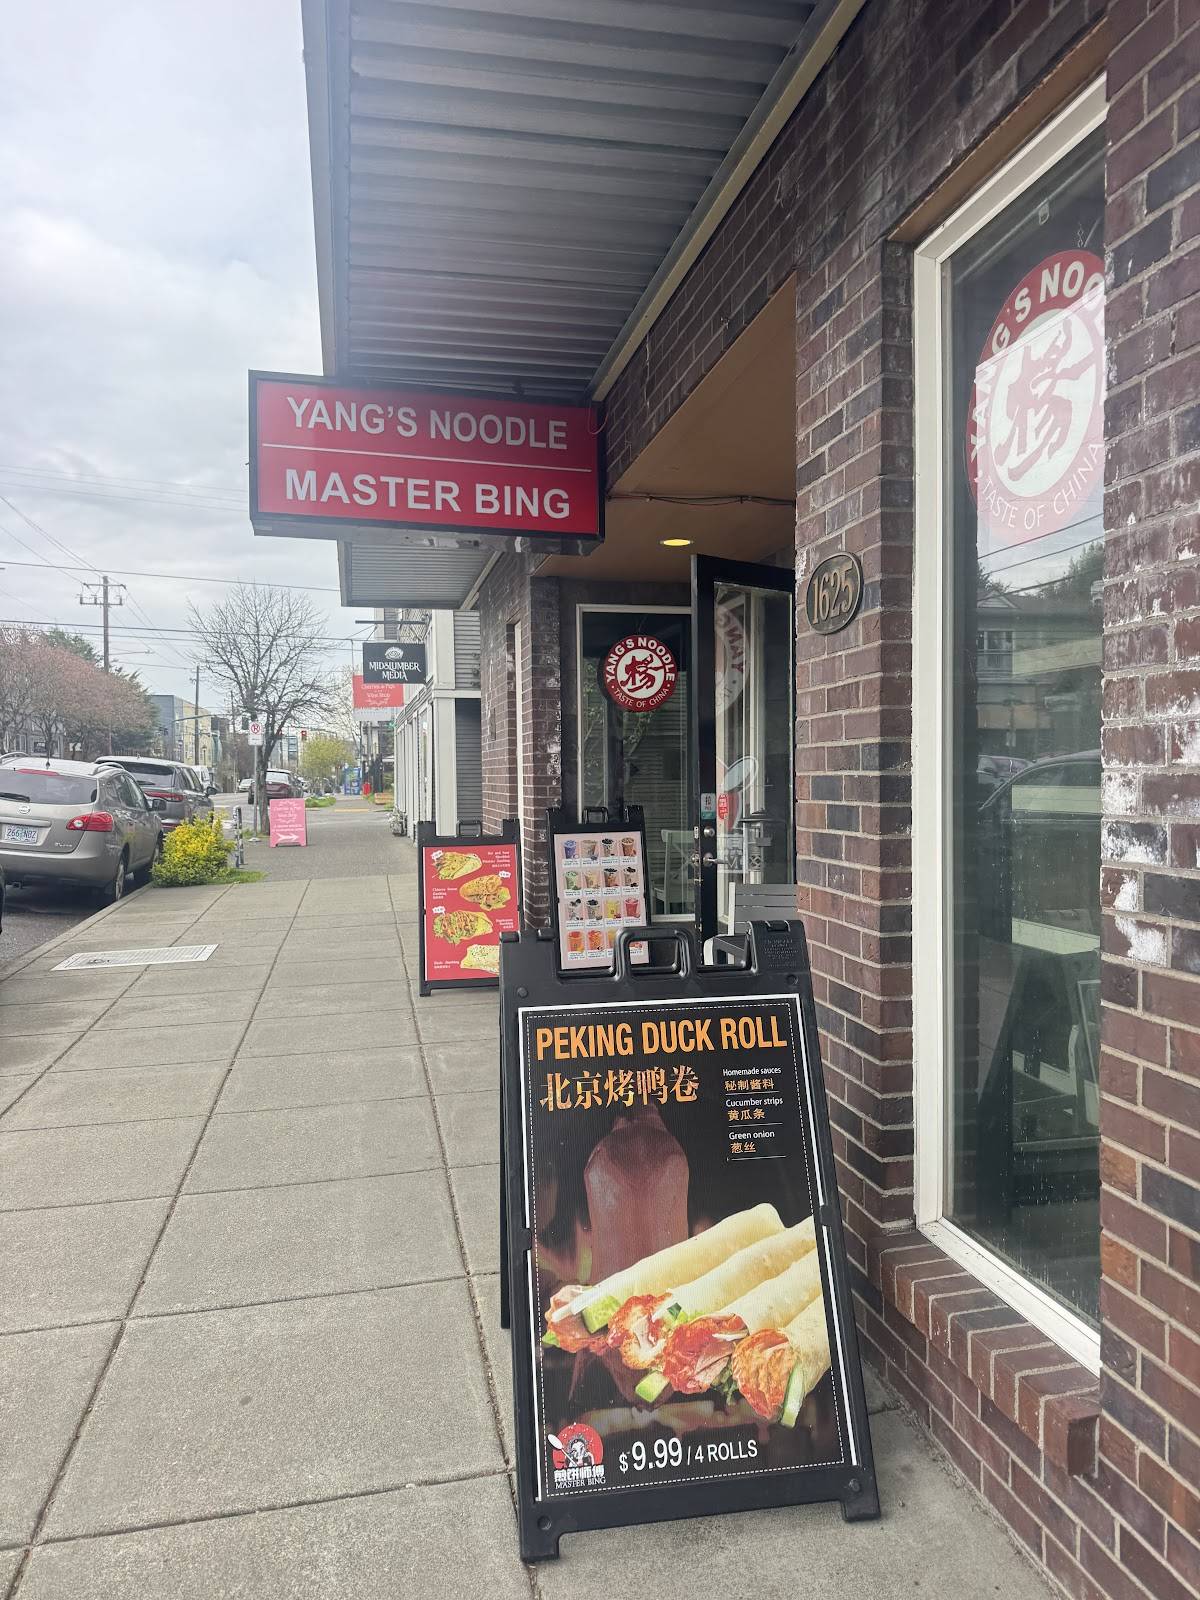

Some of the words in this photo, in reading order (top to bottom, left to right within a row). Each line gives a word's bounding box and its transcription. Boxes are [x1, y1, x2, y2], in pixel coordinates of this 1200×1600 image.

[286, 396, 418, 438] YANG'S
[430, 410, 567, 450] NOODLE
[285, 469, 462, 512] MASTER
[475, 484, 570, 519] BING
[982, 475, 1018, 528] TASTE
[1024, 504, 1045, 530] OF
[1054, 444, 1105, 514] CHINA
[813, 560, 853, 625] 1625
[369, 662, 421, 672] MIDSLUMBER
[606, 638, 635, 683] YANG'S
[638, 637, 675, 681] NOODLE
[382, 671, 408, 681] MEDIA
[614, 688, 634, 706] TASTE
[649, 688, 669, 706] CHINA
[536, 1023, 634, 1061] PEKING
[642, 1019, 714, 1055] DUCK
[720, 1016, 788, 1050] ROLL
[722, 1066, 760, 1076] Homemade
[761, 1067, 782, 1075] sauces
[539, 1064, 700, 1112] 北京烤鸭卷
[724, 1078, 775, 1091] 秘制酱料
[726, 1098, 762, 1107] Cucumber
[764, 1097, 783, 1106] strips
[728, 1108, 765, 1121] 黄瓜条
[729, 1131, 752, 1140] Green
[753, 1130, 775, 1139] onion
[730, 1141, 757, 1153] 葱丝
[707, 1440, 758, 1462] ROLLS
[556, 1479, 585, 1489] MASTER
[588, 1477, 606, 1486] BING
